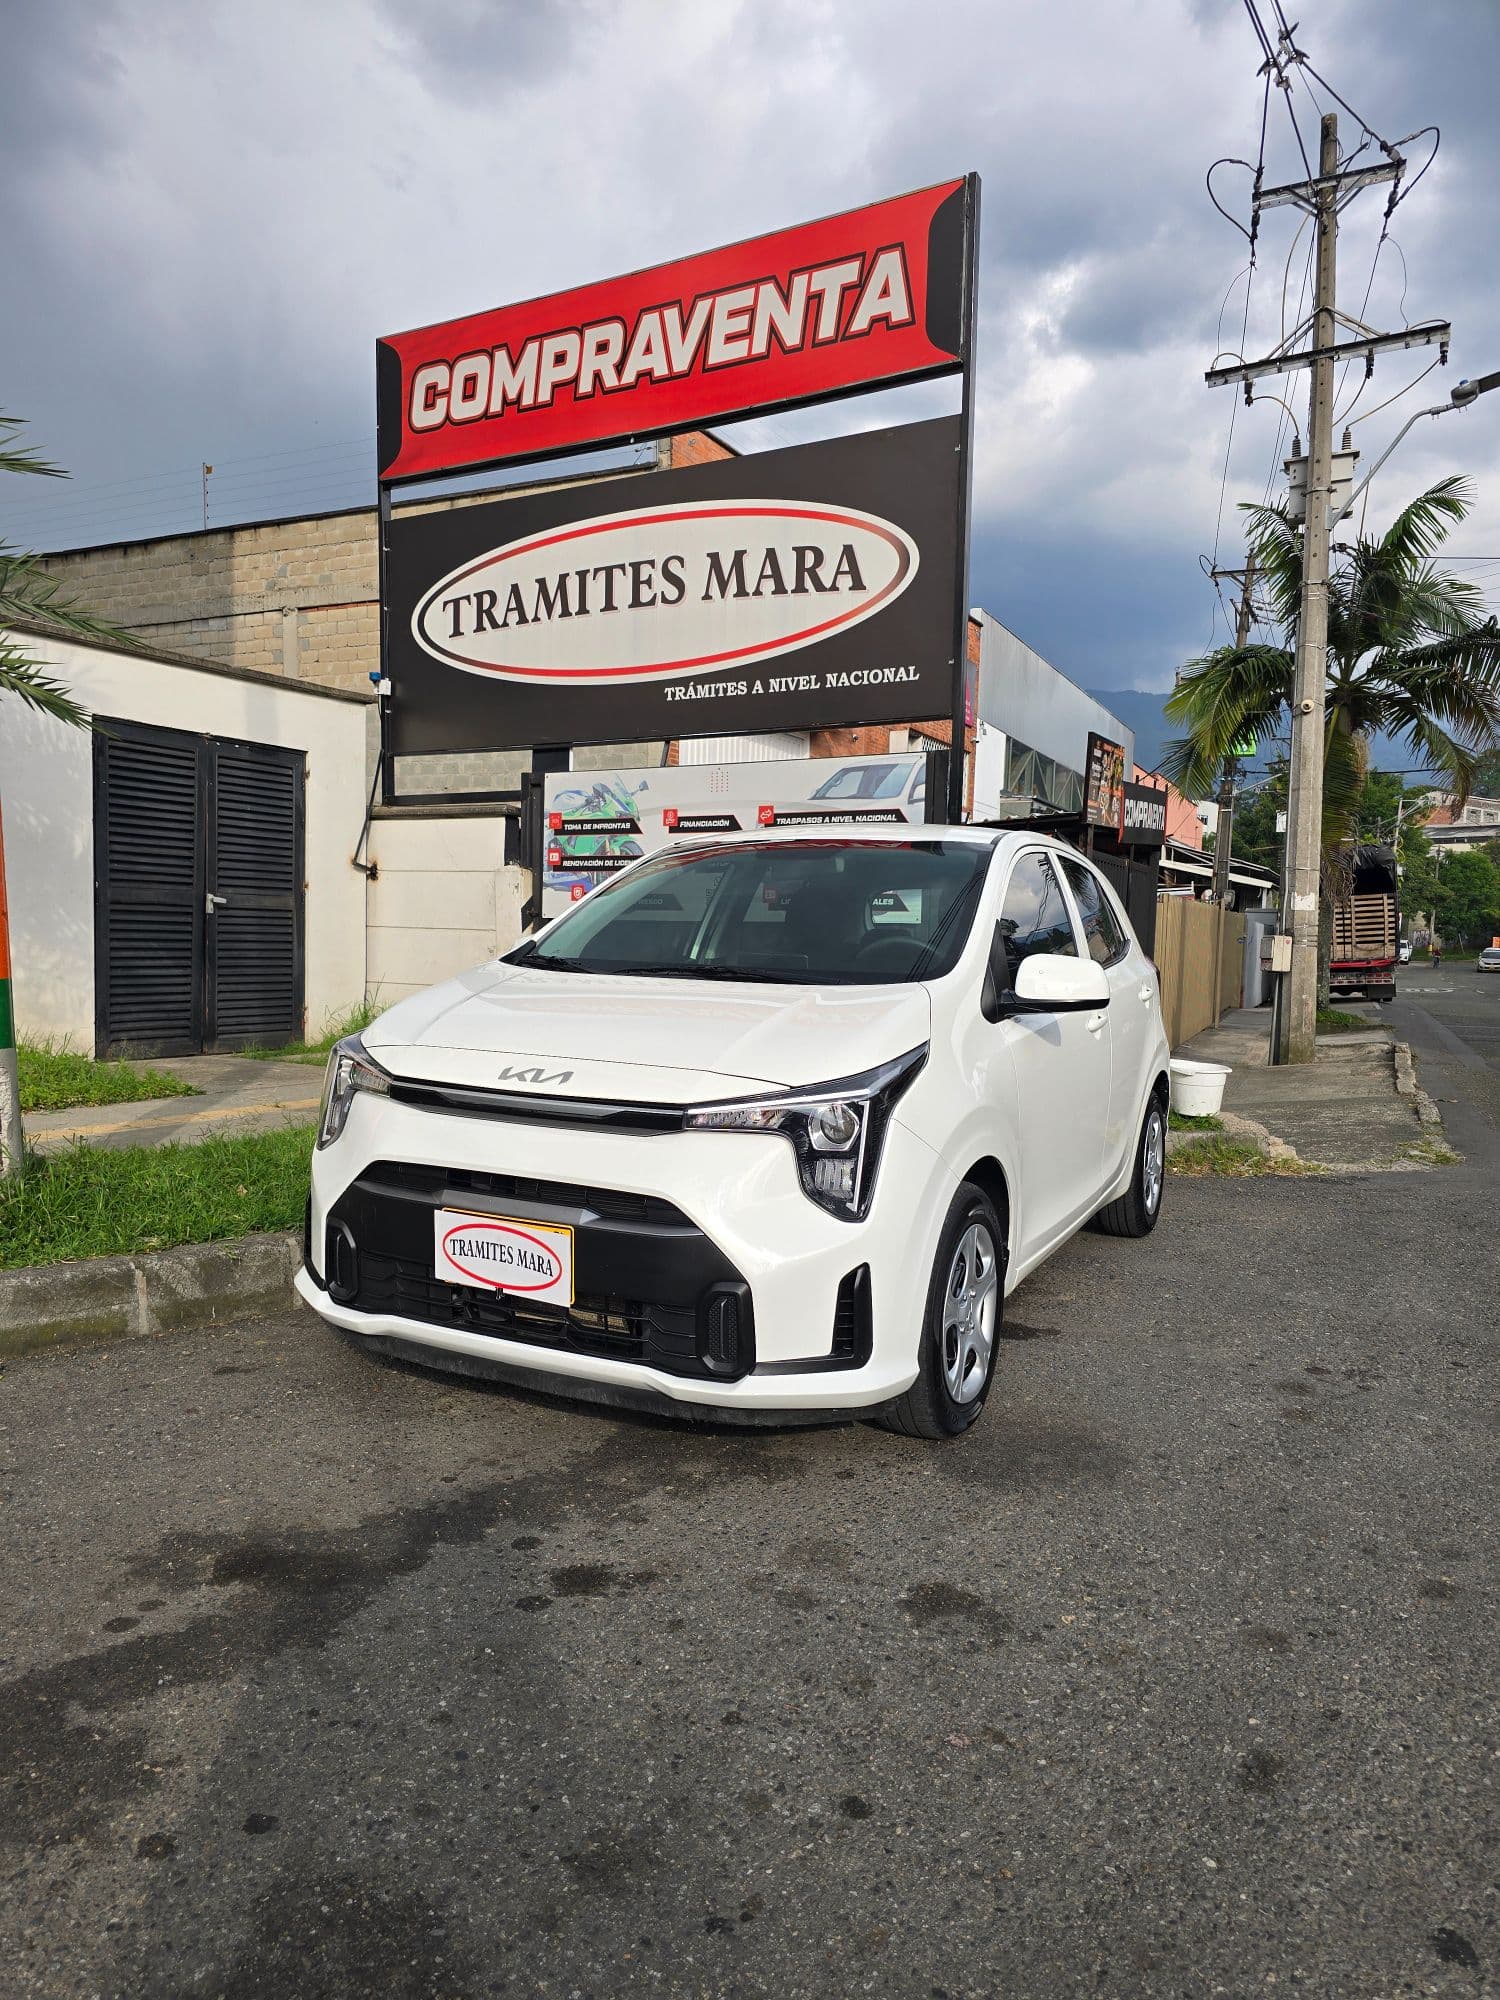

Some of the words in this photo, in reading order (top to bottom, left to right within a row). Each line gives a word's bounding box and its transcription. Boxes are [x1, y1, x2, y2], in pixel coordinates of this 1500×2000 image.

[410, 244, 914, 432] COMPRAVENTA
[441, 554, 687, 639] TRAMITES
[701, 542, 867, 603] MARA
[664, 681, 748, 701] TRÁMITES
[752, 680, 765, 695] A
[768, 674, 821, 694] NIVEL
[825, 665, 921, 689] NACIONAL
[679, 819, 730, 828] FINANCIACIÓN
[776, 816, 823, 825] TRASPASOS
[831, 815, 854, 823] NIVEL
[855, 814, 897, 822] NACIONAL
[1124, 798, 1166, 831] COMPRAVENTA
[562, 859, 604, 867] RENOVACIÓN
[497, 1066, 575, 1085] KIA
[449, 1238, 514, 1265] TRAMITES
[516, 1248, 554, 1277] MARA
